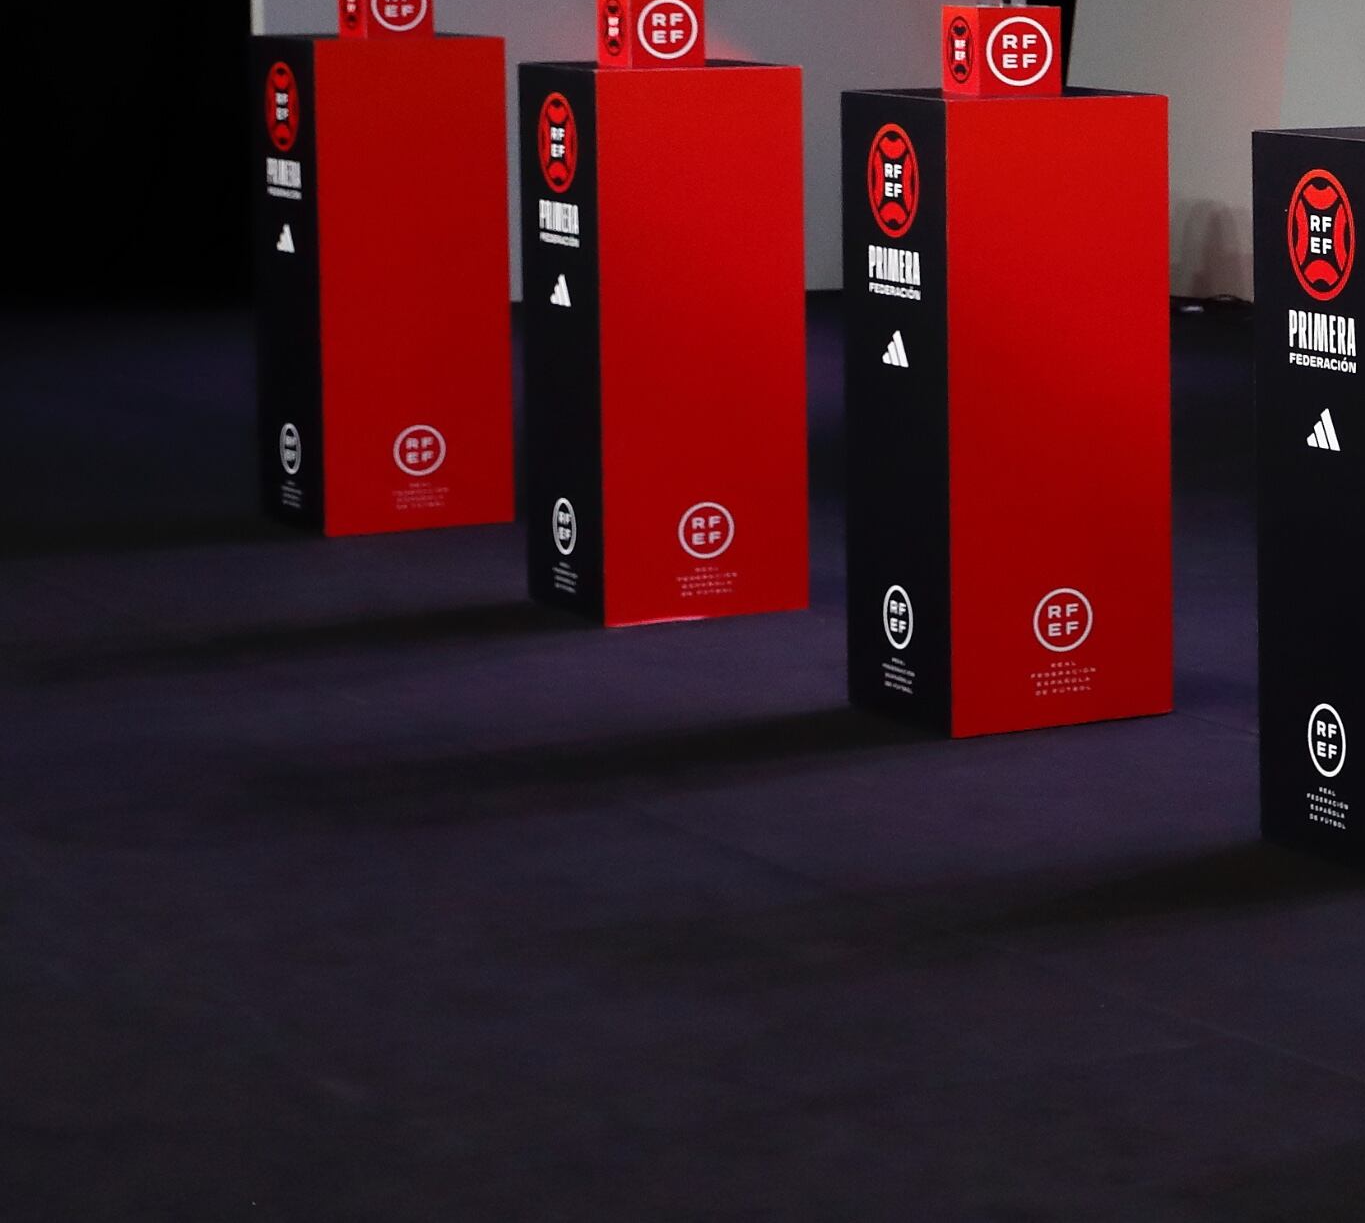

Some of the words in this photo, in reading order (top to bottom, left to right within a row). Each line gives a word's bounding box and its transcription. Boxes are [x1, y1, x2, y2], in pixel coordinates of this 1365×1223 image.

[652, 13, 684, 27] RF
[652, 30, 684, 44] EF
[1002, 34, 1037, 49] RF
[1002, 53, 1037, 69] EF
[1310, 214, 1332, 233] RF
[1310, 236, 1332, 255] EF
[868, 245, 921, 286] PRIMERA
[1288, 309, 1356, 357] PRIMERA
[1289, 352, 1357, 374] FEDERACIÓN
[691, 515, 722, 529] RF
[691, 531, 722, 545] EF
[1048, 603, 1079, 619] RF
[1048, 621, 1079, 637] EF
[1317, 720, 1337, 739] RF
[1317, 741, 1337, 759] EF
